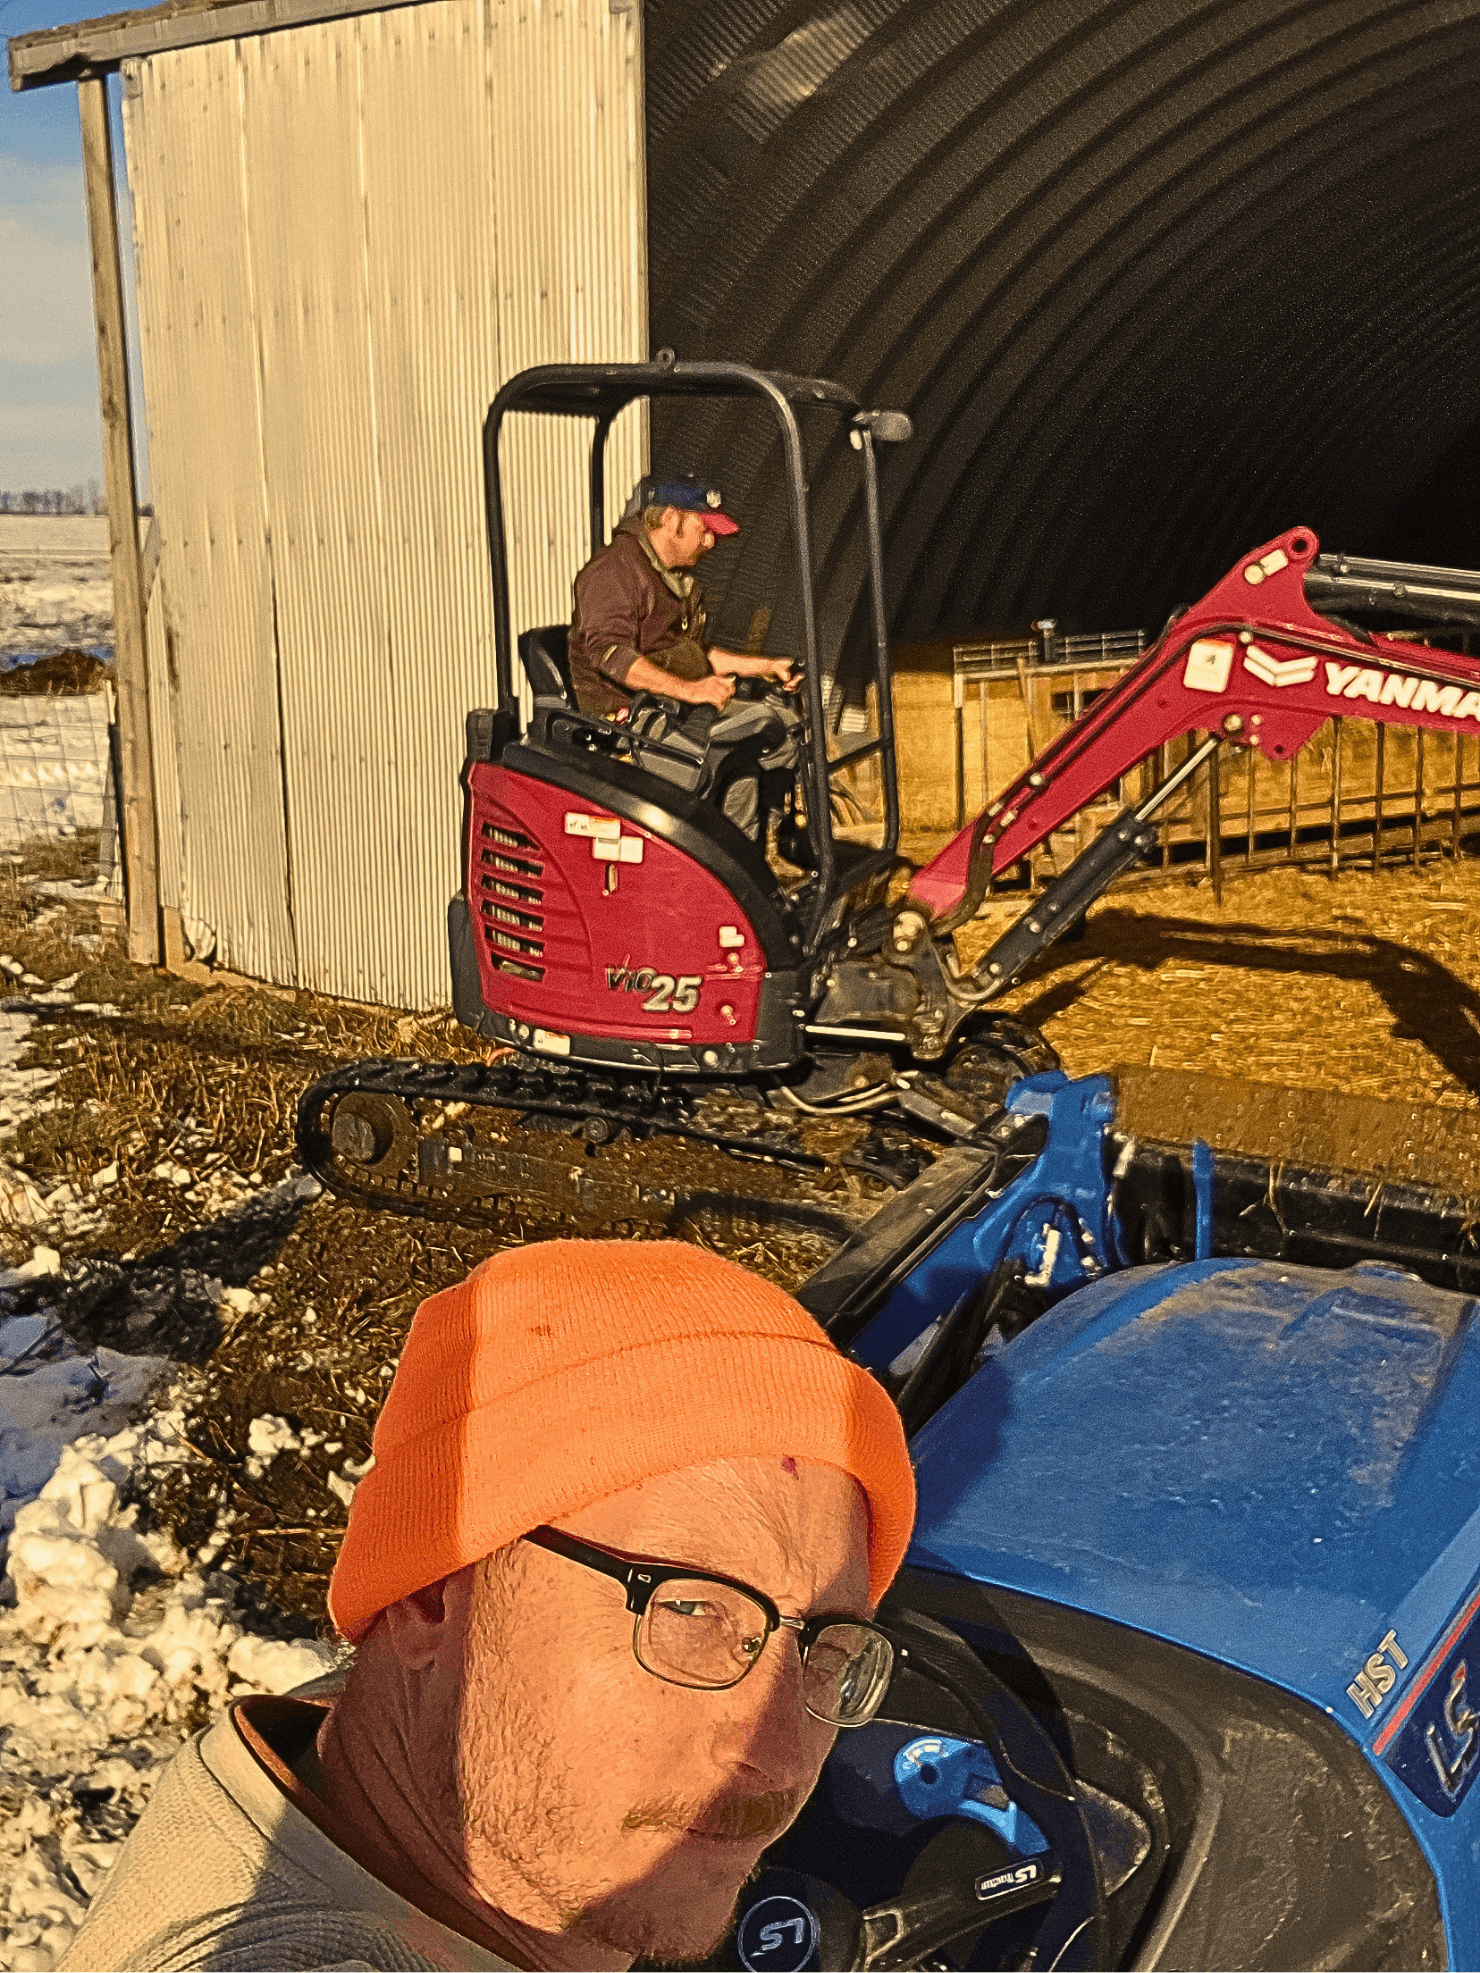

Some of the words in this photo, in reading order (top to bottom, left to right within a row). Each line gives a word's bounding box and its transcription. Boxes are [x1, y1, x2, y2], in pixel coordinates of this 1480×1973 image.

[1346, 1628, 1408, 1719] HST
[1015, 1864, 1037, 1884] LS
[752, 1917, 805, 1956] LS
